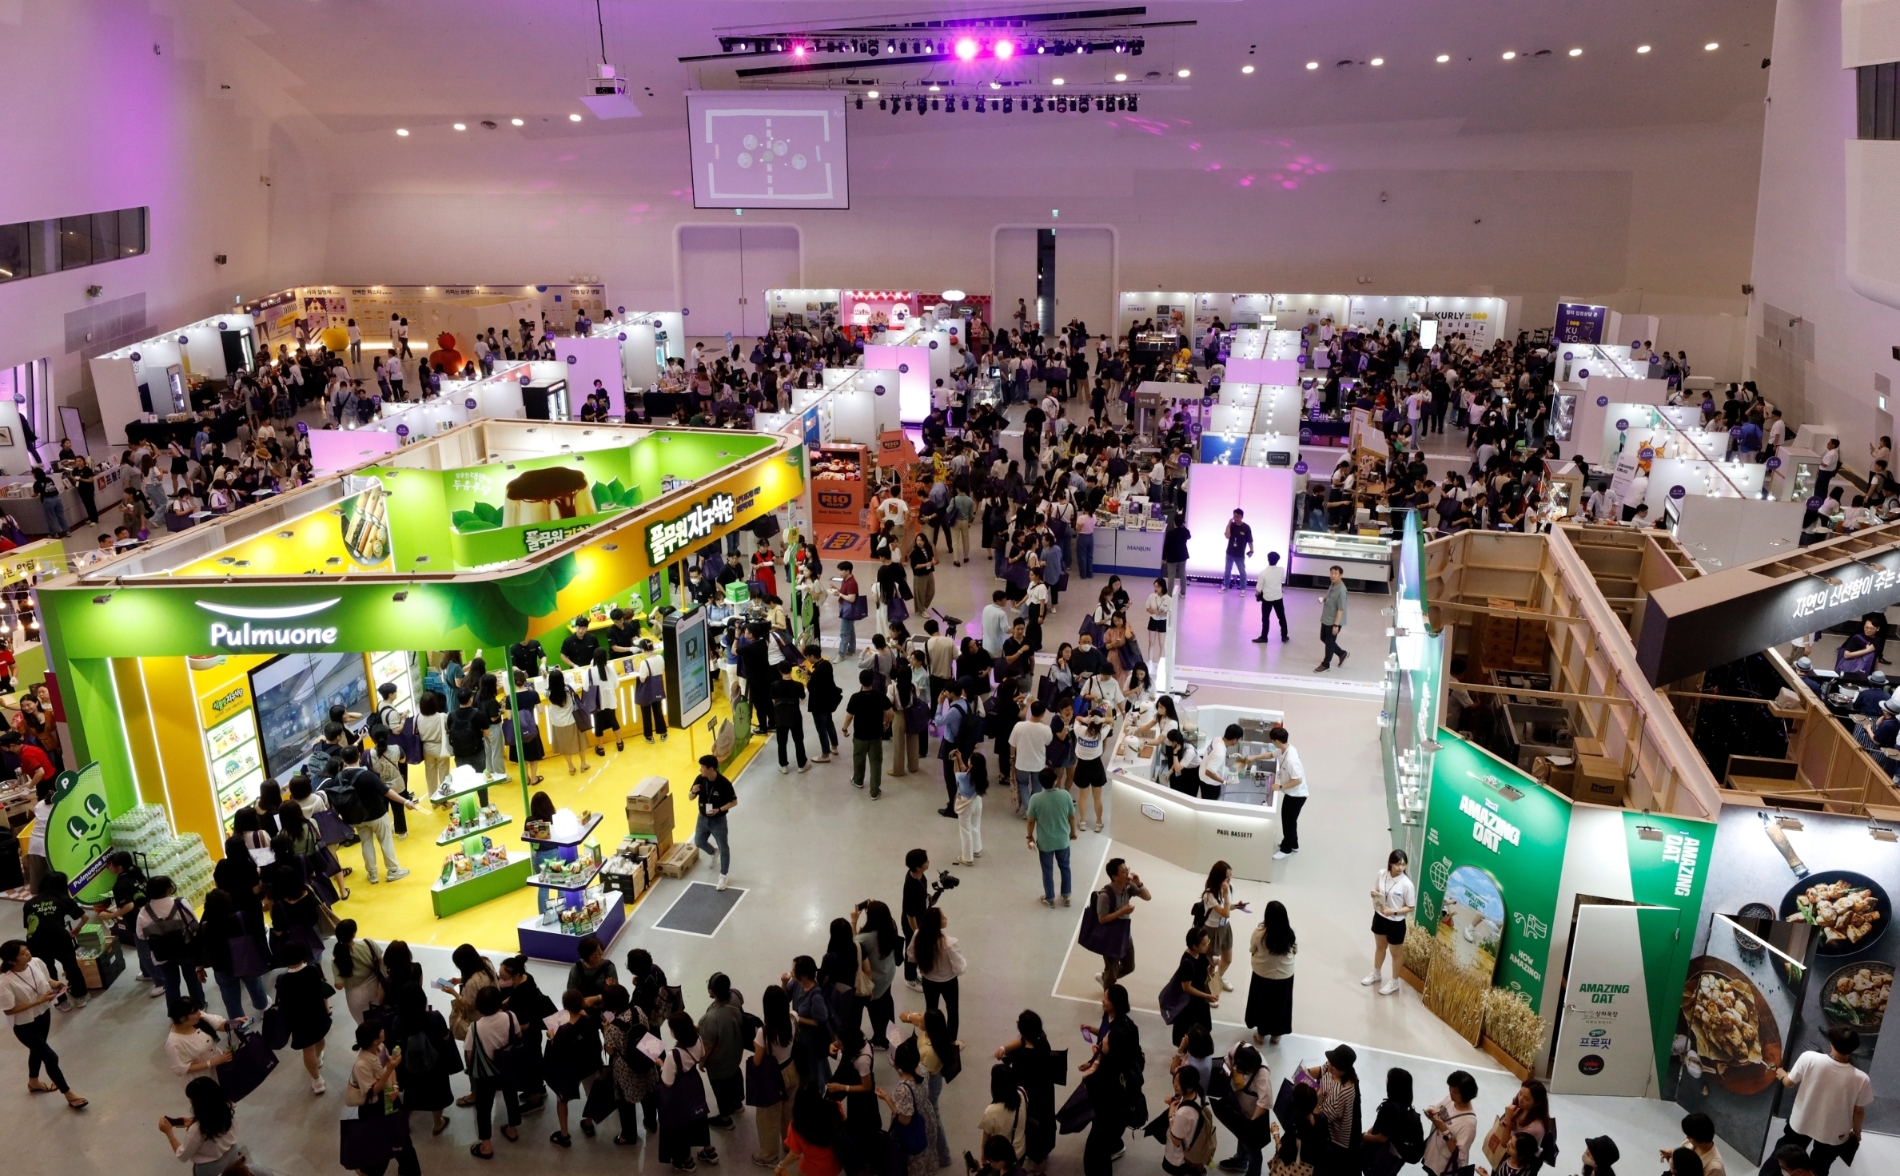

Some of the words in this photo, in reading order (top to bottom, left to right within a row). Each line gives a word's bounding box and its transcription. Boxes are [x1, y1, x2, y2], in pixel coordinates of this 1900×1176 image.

[1434, 311, 1464, 320] KURLY
[821, 494, 849, 504] RIO
[1792, 589, 1830, 619] 자연의
[1829, 574, 1874, 607] 신선함이
[211, 622, 338, 647] Pulmuone
[61, 778, 69, 789] P
[1459, 794, 1521, 847] AMAZING
[1216, 828, 1230, 836] PAUL
[1230, 830, 1253, 839] BASSETT
[1472, 821, 1503, 854] OAT
[1662, 834, 1684, 864] OAT
[1674, 836, 1700, 897] AMAZING
[73, 861, 103, 888] Pulmuone
[1518, 950, 1534, 965] HOW
[1509, 953, 1541, 982] AMAZING!
[1579, 983, 1630, 994] AMAZING
[1591, 993, 1615, 1004] OAT
[1595, 1010, 1618, 1018] 상하목장
[1579, 1037, 1611, 1050] 프로핏
